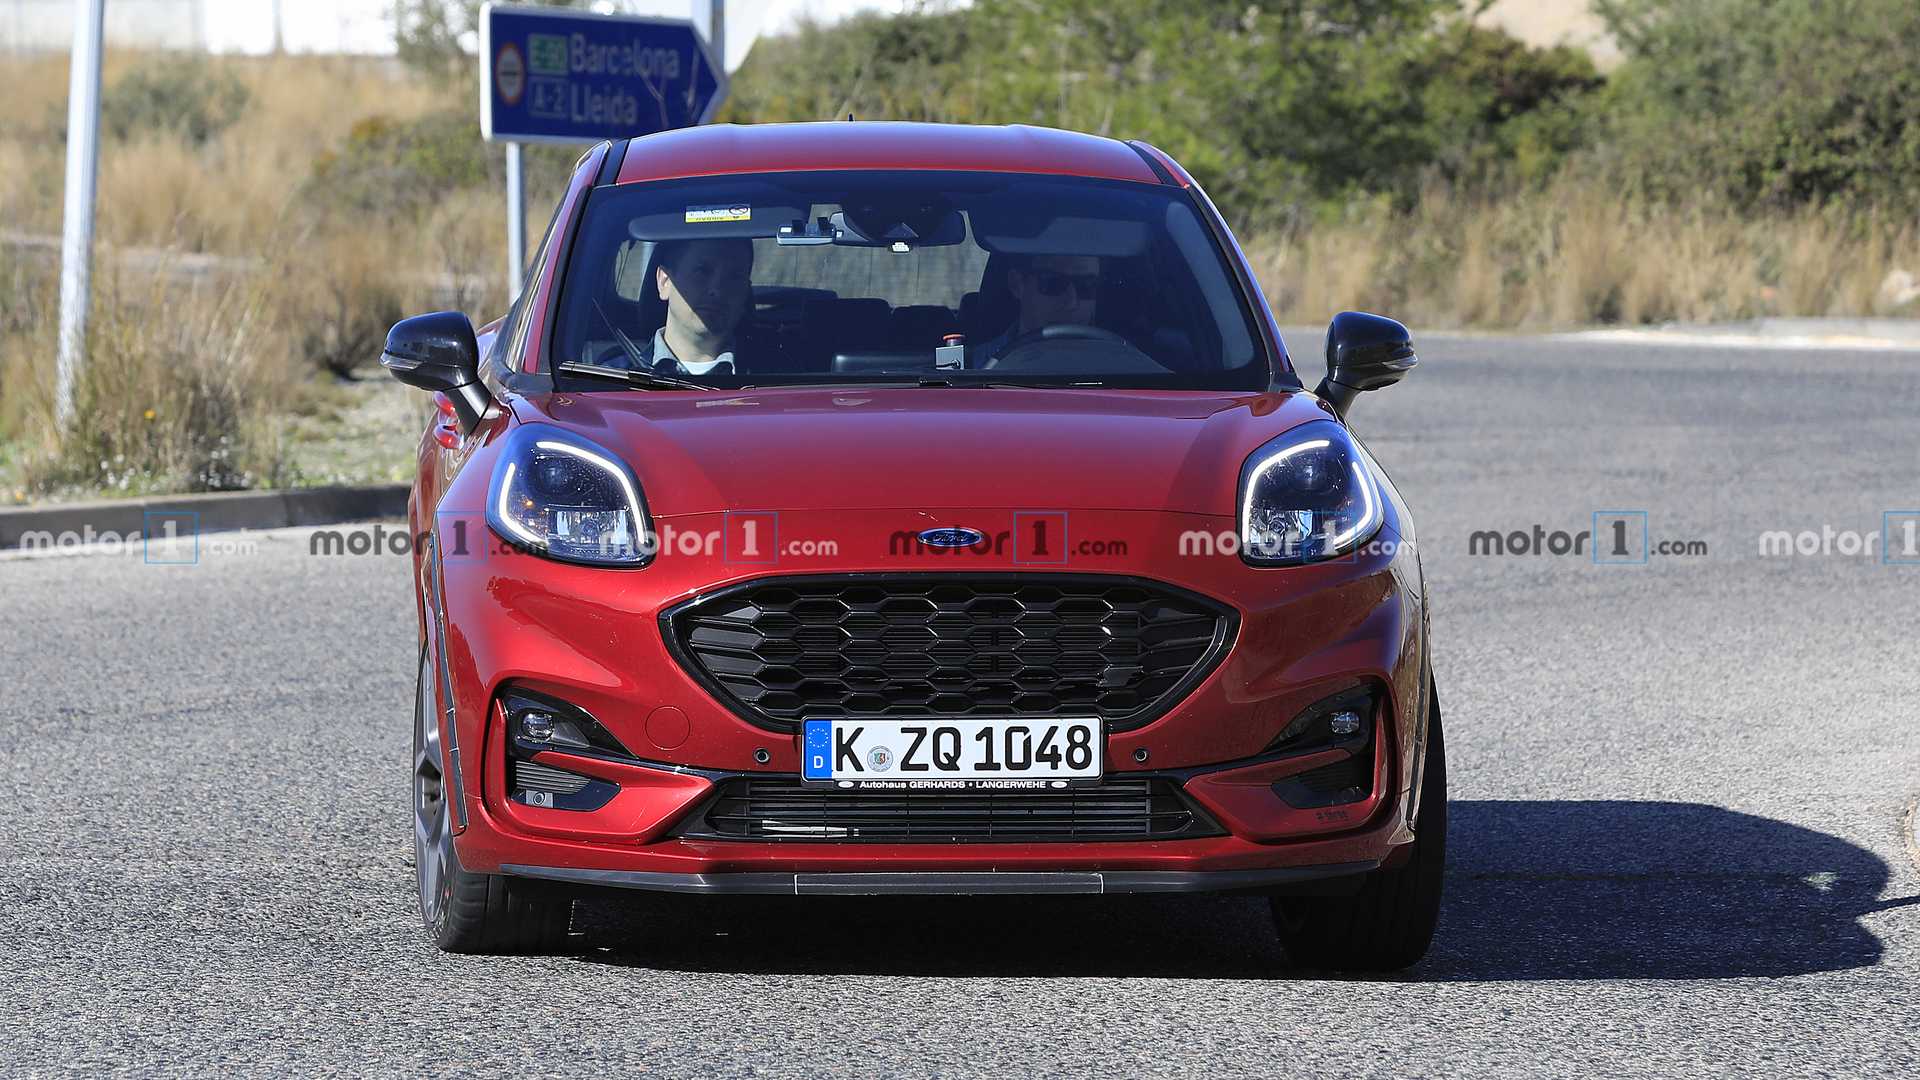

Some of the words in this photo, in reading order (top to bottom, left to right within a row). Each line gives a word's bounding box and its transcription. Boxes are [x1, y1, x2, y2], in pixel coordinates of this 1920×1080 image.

[570, 33, 681, 79] Barcelona
[570, 83, 638, 125] Lleida
[813, 755, 824, 769] D
[835, 727, 864, 772] K
[900, 726, 961, 772] ZQ
[974, 725, 1092, 771] 1048
[859, 781, 907, 789] Autohaus
[909, 780, 966, 789] GERHARDS
[975, 780, 1046, 789] LANGERWEHE
